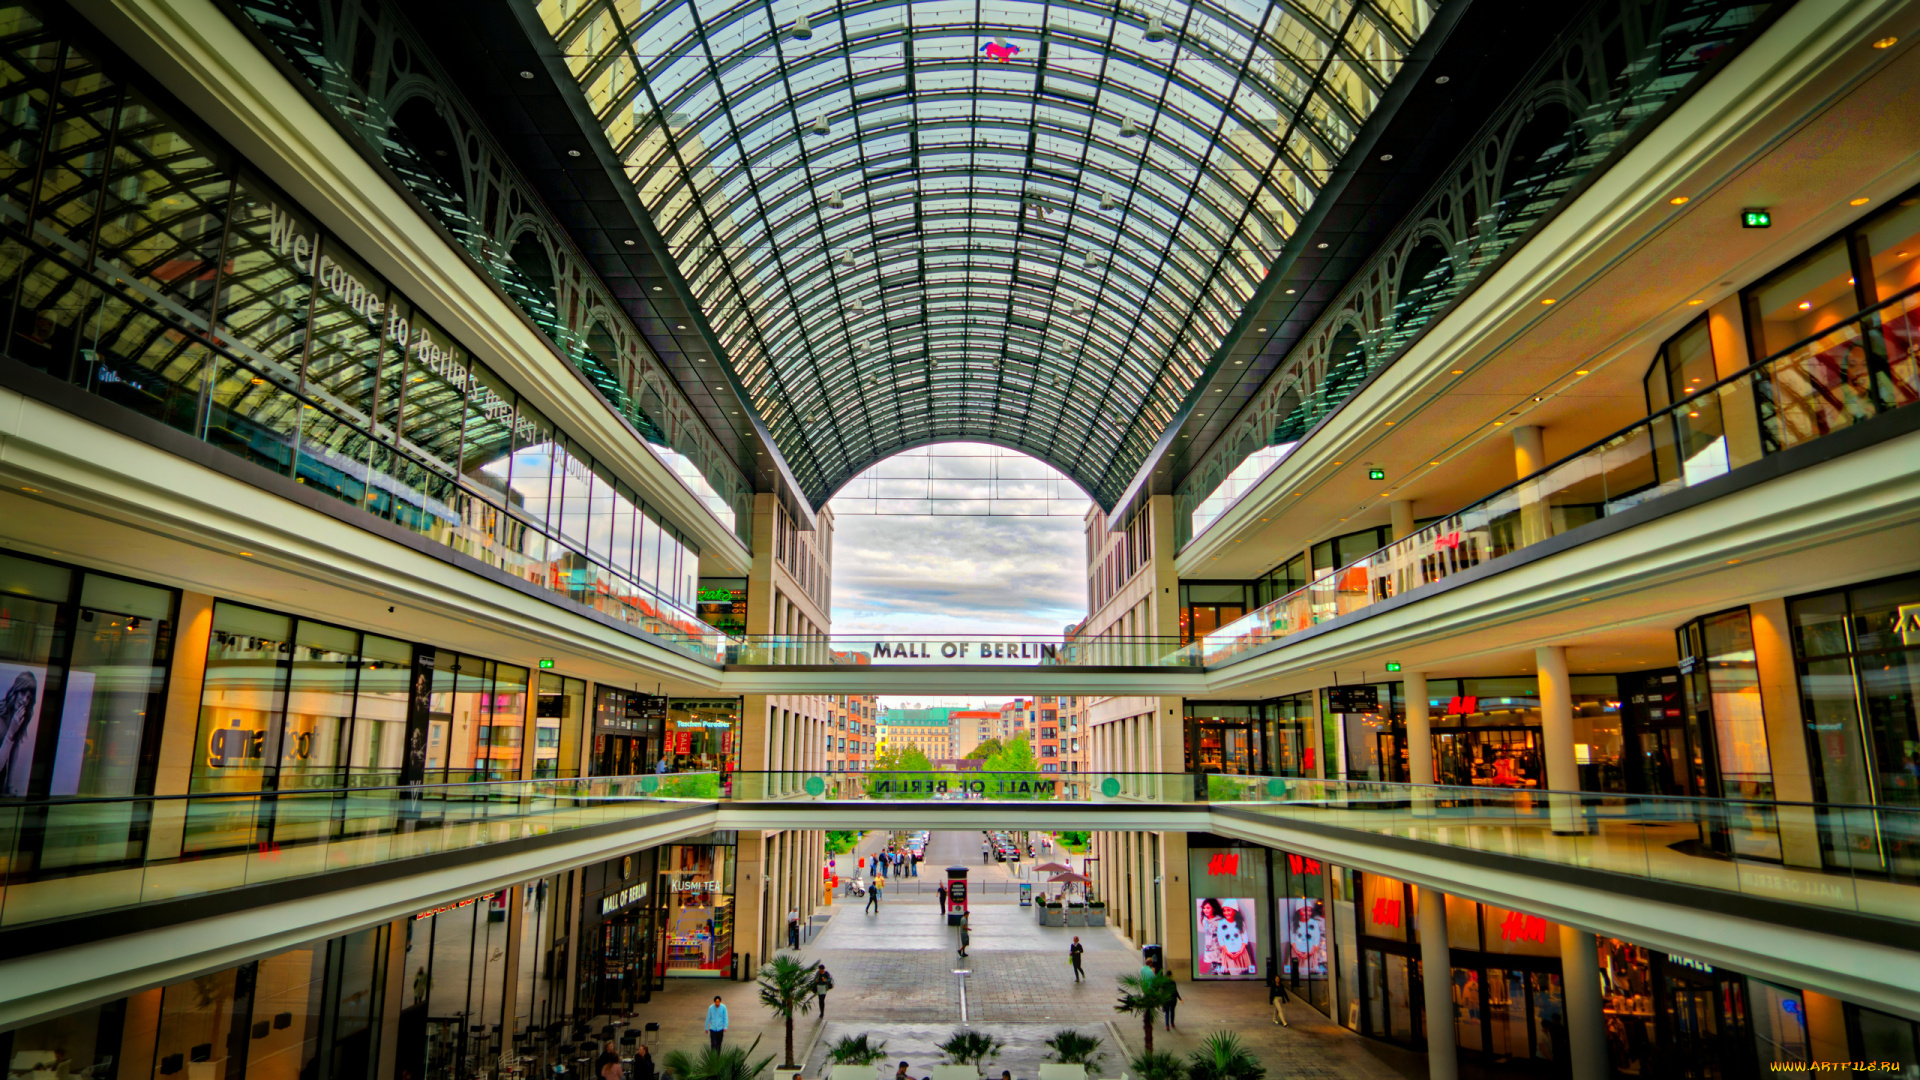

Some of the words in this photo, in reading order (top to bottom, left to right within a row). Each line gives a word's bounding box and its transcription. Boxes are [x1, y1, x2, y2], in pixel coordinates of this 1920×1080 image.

[270, 201, 380, 325] Welcome
[390, 303, 409, 347] to
[418, 327, 479, 401] Berlin's
[484, 388, 537, 446] greatest
[873, 641, 931, 658] MALL
[940, 641, 970, 659] OF
[980, 642, 1057, 659] BERLIN
[680, 732, 688, 752] SALE
[1207, 853, 1240, 876] H&M
[602, 893, 619, 915] MALL
[619, 889, 629, 907] OF
[628, 881, 648, 903] BERLIN
[671, 879, 701, 892] KUSMI
[703, 880, 721, 893] TEA
[1372, 897, 1400, 928] H&M
[1501, 911, 1547, 944] H&M
